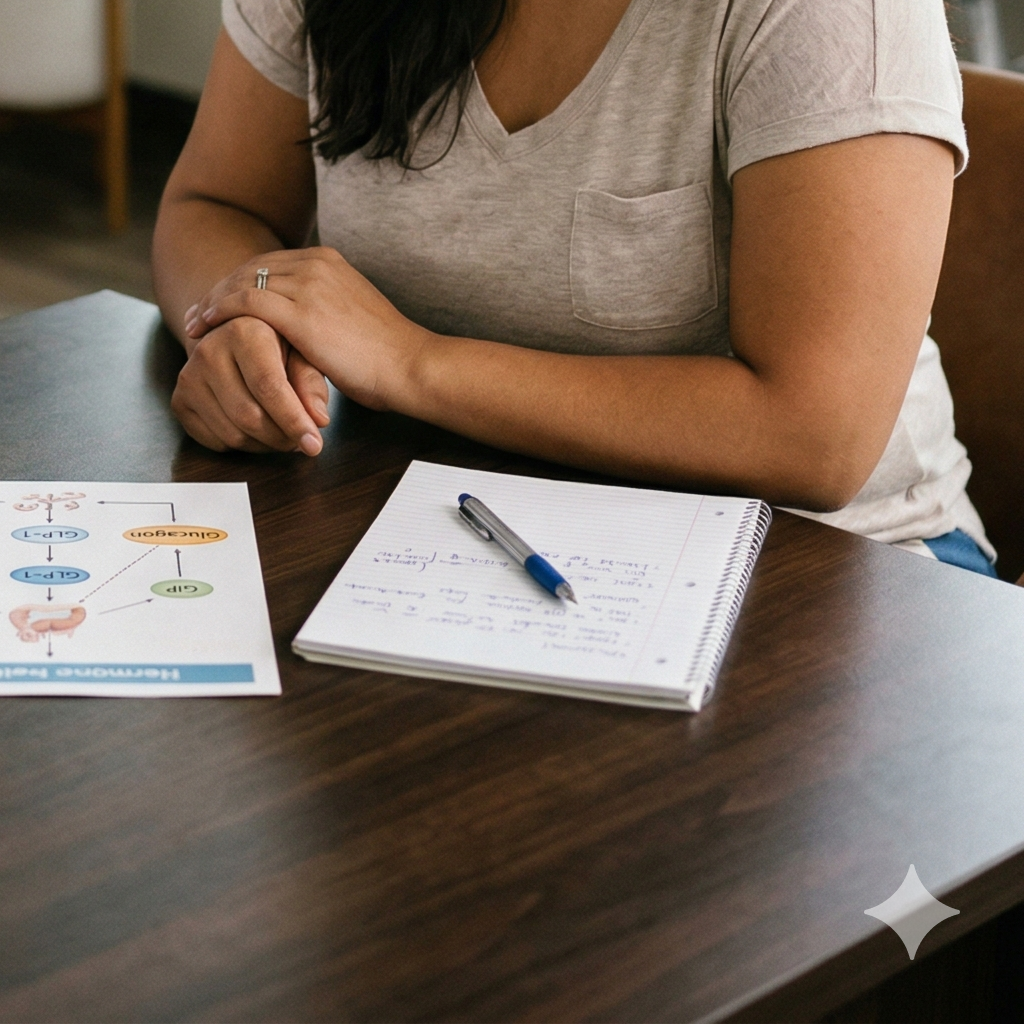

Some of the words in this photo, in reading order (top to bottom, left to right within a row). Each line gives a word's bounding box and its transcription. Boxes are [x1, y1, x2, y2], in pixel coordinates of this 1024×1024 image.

[23, 529, 79, 539] GLP-1
[130, 529, 221, 541] Glucagon
[24, 570, 81, 580] GLP-1
[165, 584, 198, 594] GIP
